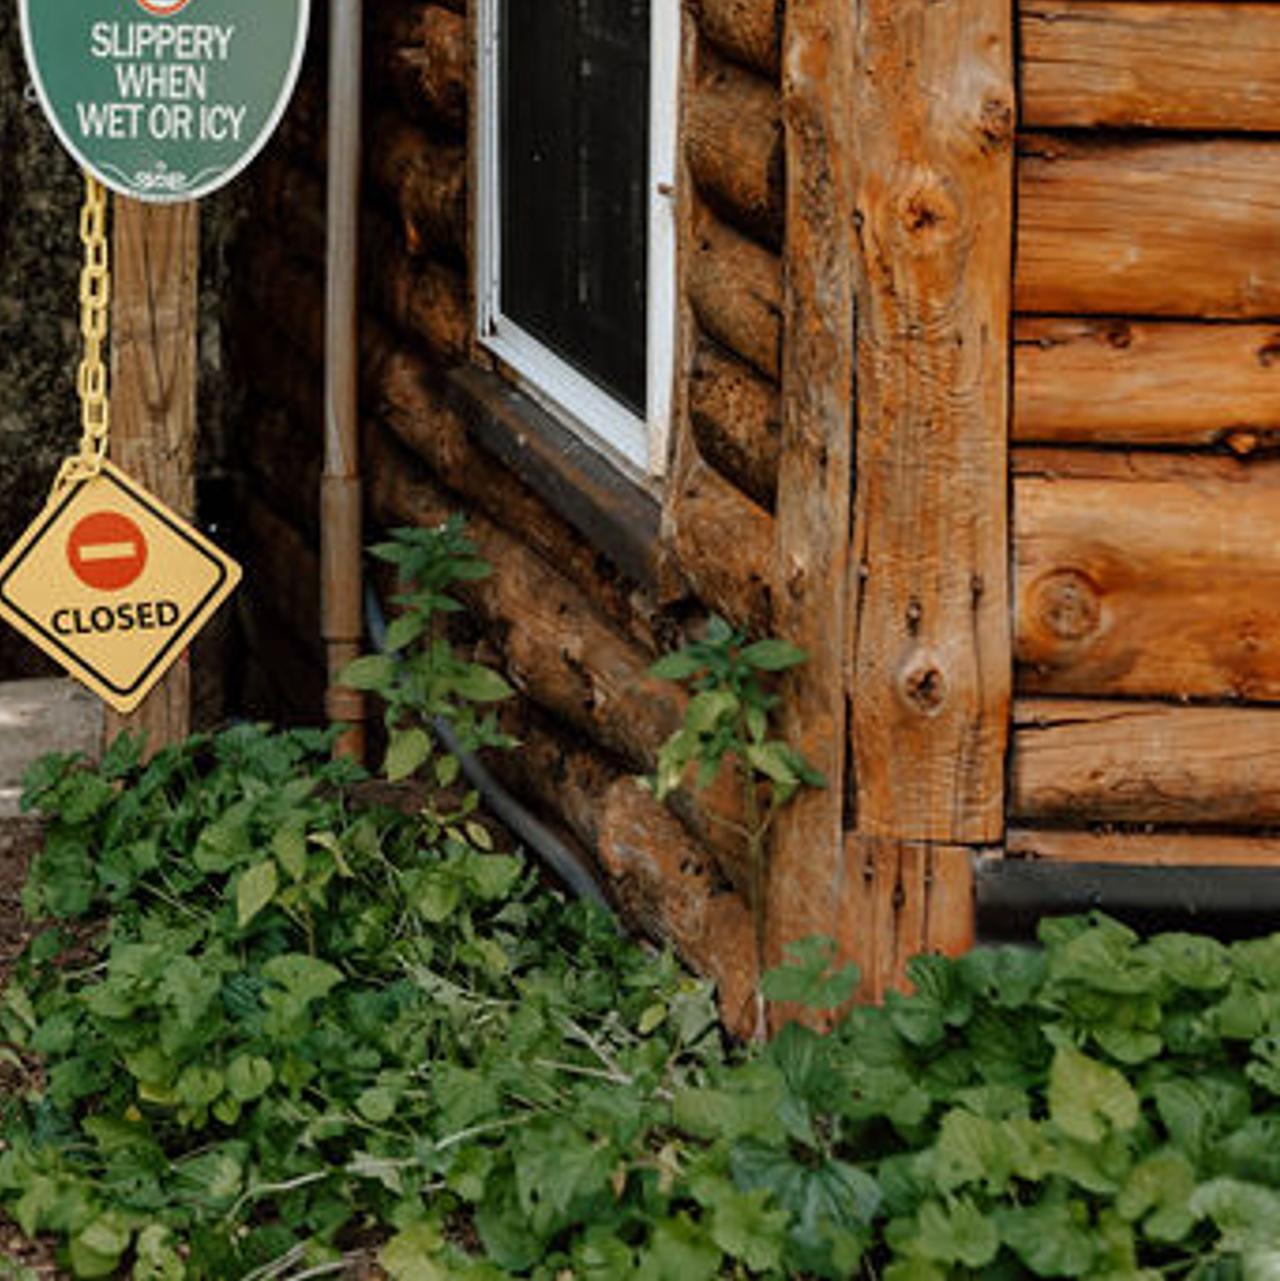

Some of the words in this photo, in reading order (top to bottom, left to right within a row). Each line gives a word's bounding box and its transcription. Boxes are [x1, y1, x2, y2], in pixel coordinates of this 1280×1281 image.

[90, 21, 235, 61] SLIPPERY
[115, 63, 207, 101] WHEN
[76, 103, 144, 140] WET
[148, 104, 192, 140] OR
[200, 105, 247, 141] ICY
[51, 600, 180, 635] CLOSED
